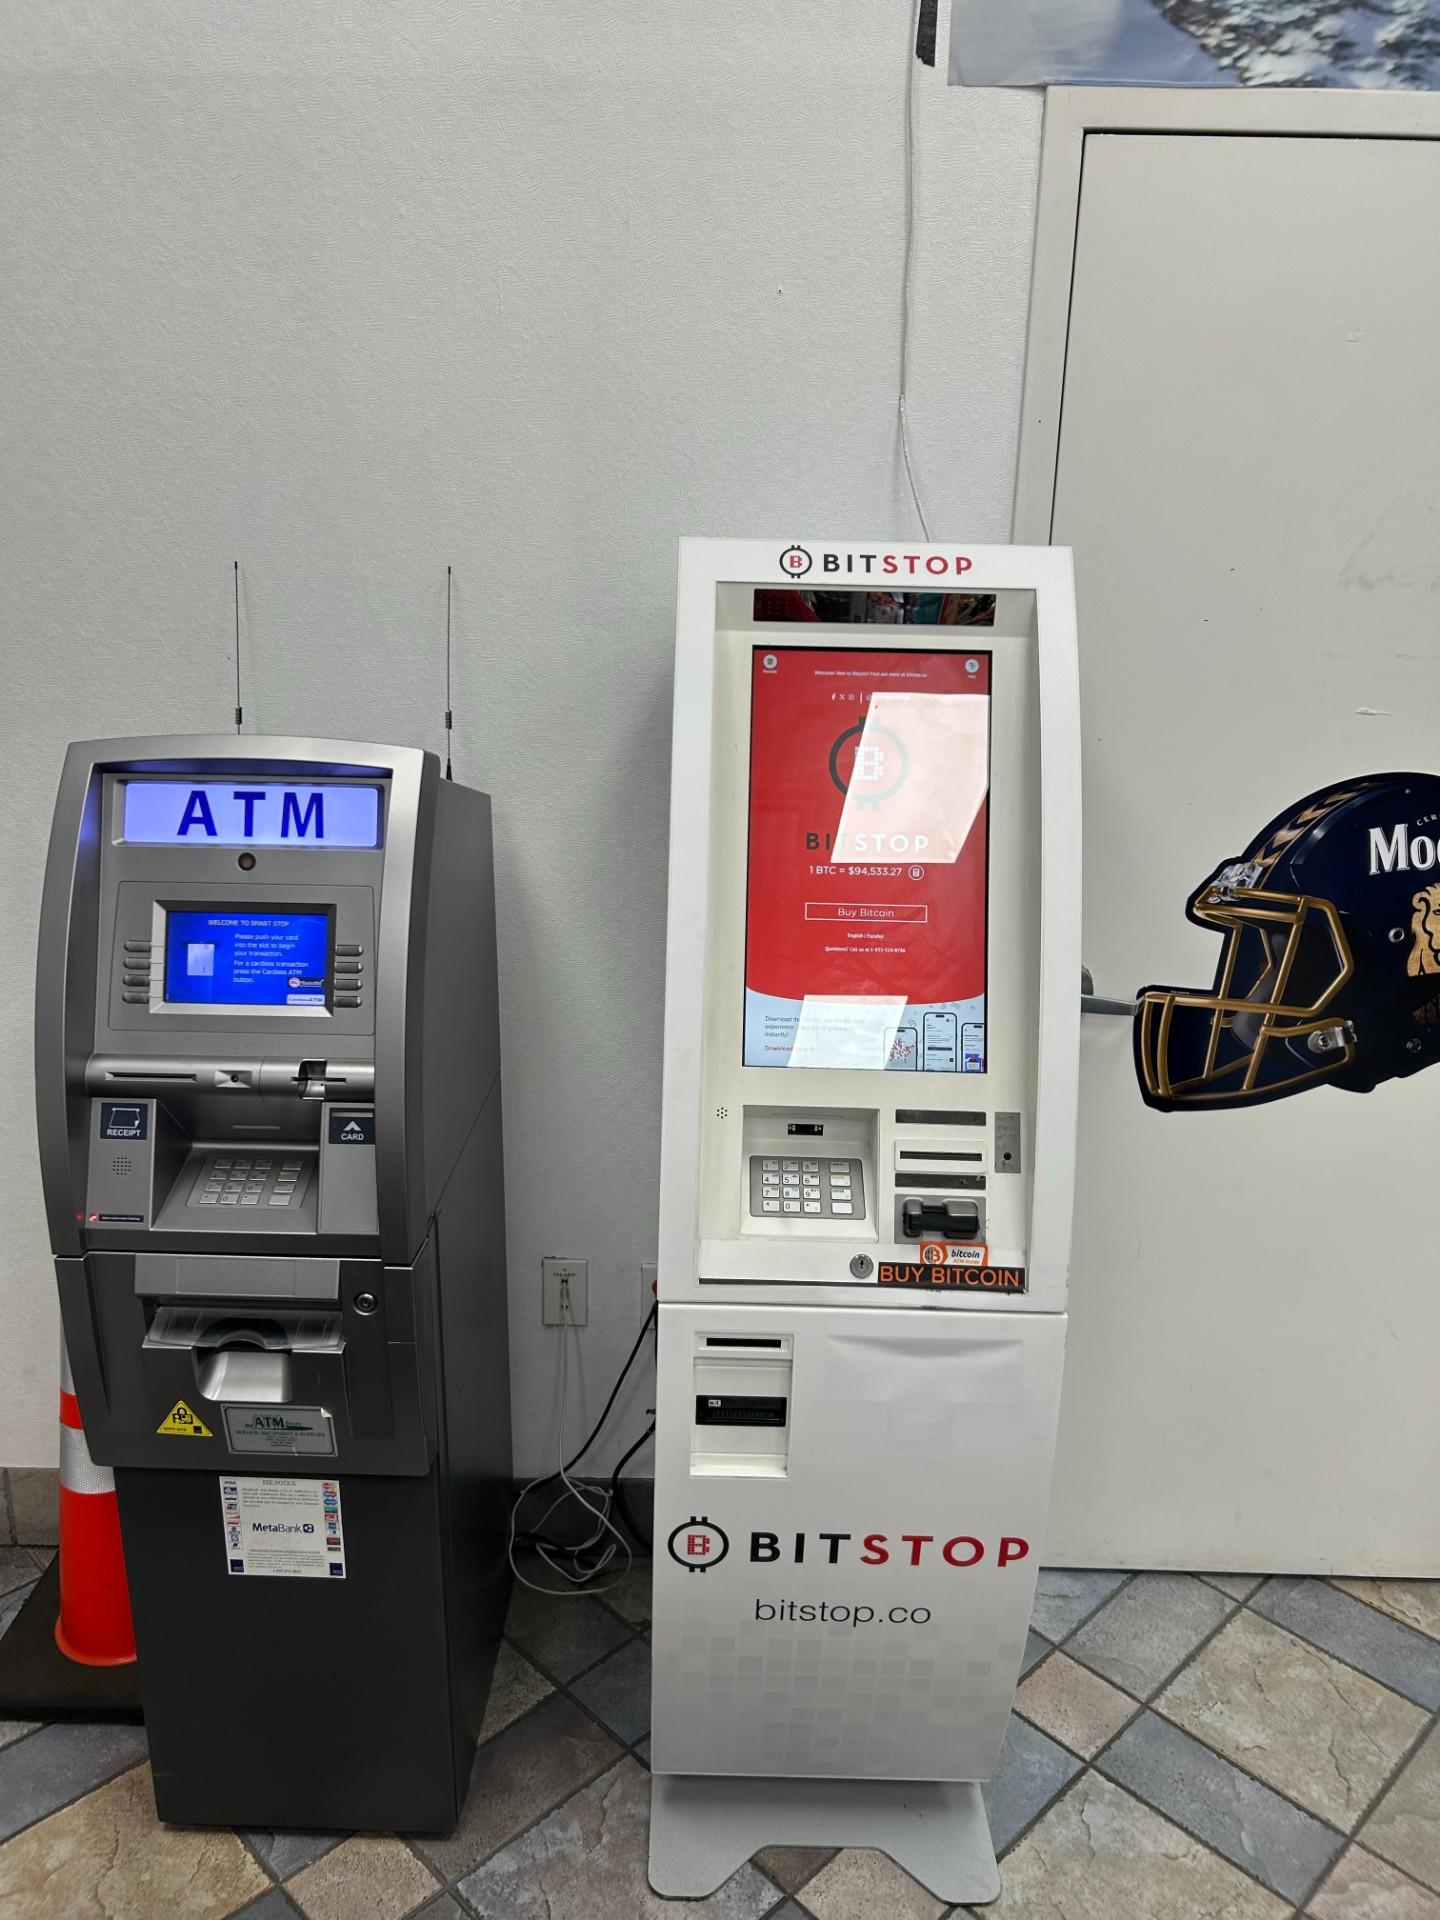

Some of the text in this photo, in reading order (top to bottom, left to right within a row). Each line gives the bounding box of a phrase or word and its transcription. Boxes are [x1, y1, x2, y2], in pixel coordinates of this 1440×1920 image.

[823, 554, 973, 575] BITSTOP
[177, 790, 324, 838] ATM
[1416, 813, 1440, 826] CER
[1368, 823, 1440, 875] Mo
[809, 866, 813, 875] 1
[816, 866, 837, 875] BTC
[848, 866, 902, 877] $94,533.27
[837, 908, 894, 918] Buy Bitcoin
[278, 942, 295, 950] begin
[106, 1128, 141, 1137] RECEIPT
[340, 1132, 365, 1141] CARD
[951, 1249, 980, 1259] bitcoin
[880, 1265, 1020, 1287] BUY BITCOIN
[255, 1416, 286, 1428] ATM
[252, 1523, 302, 1533] MetaBank
[750, 1531, 1030, 1568] BITSTOP
[755, 1599, 932, 1628] bitstop.co
